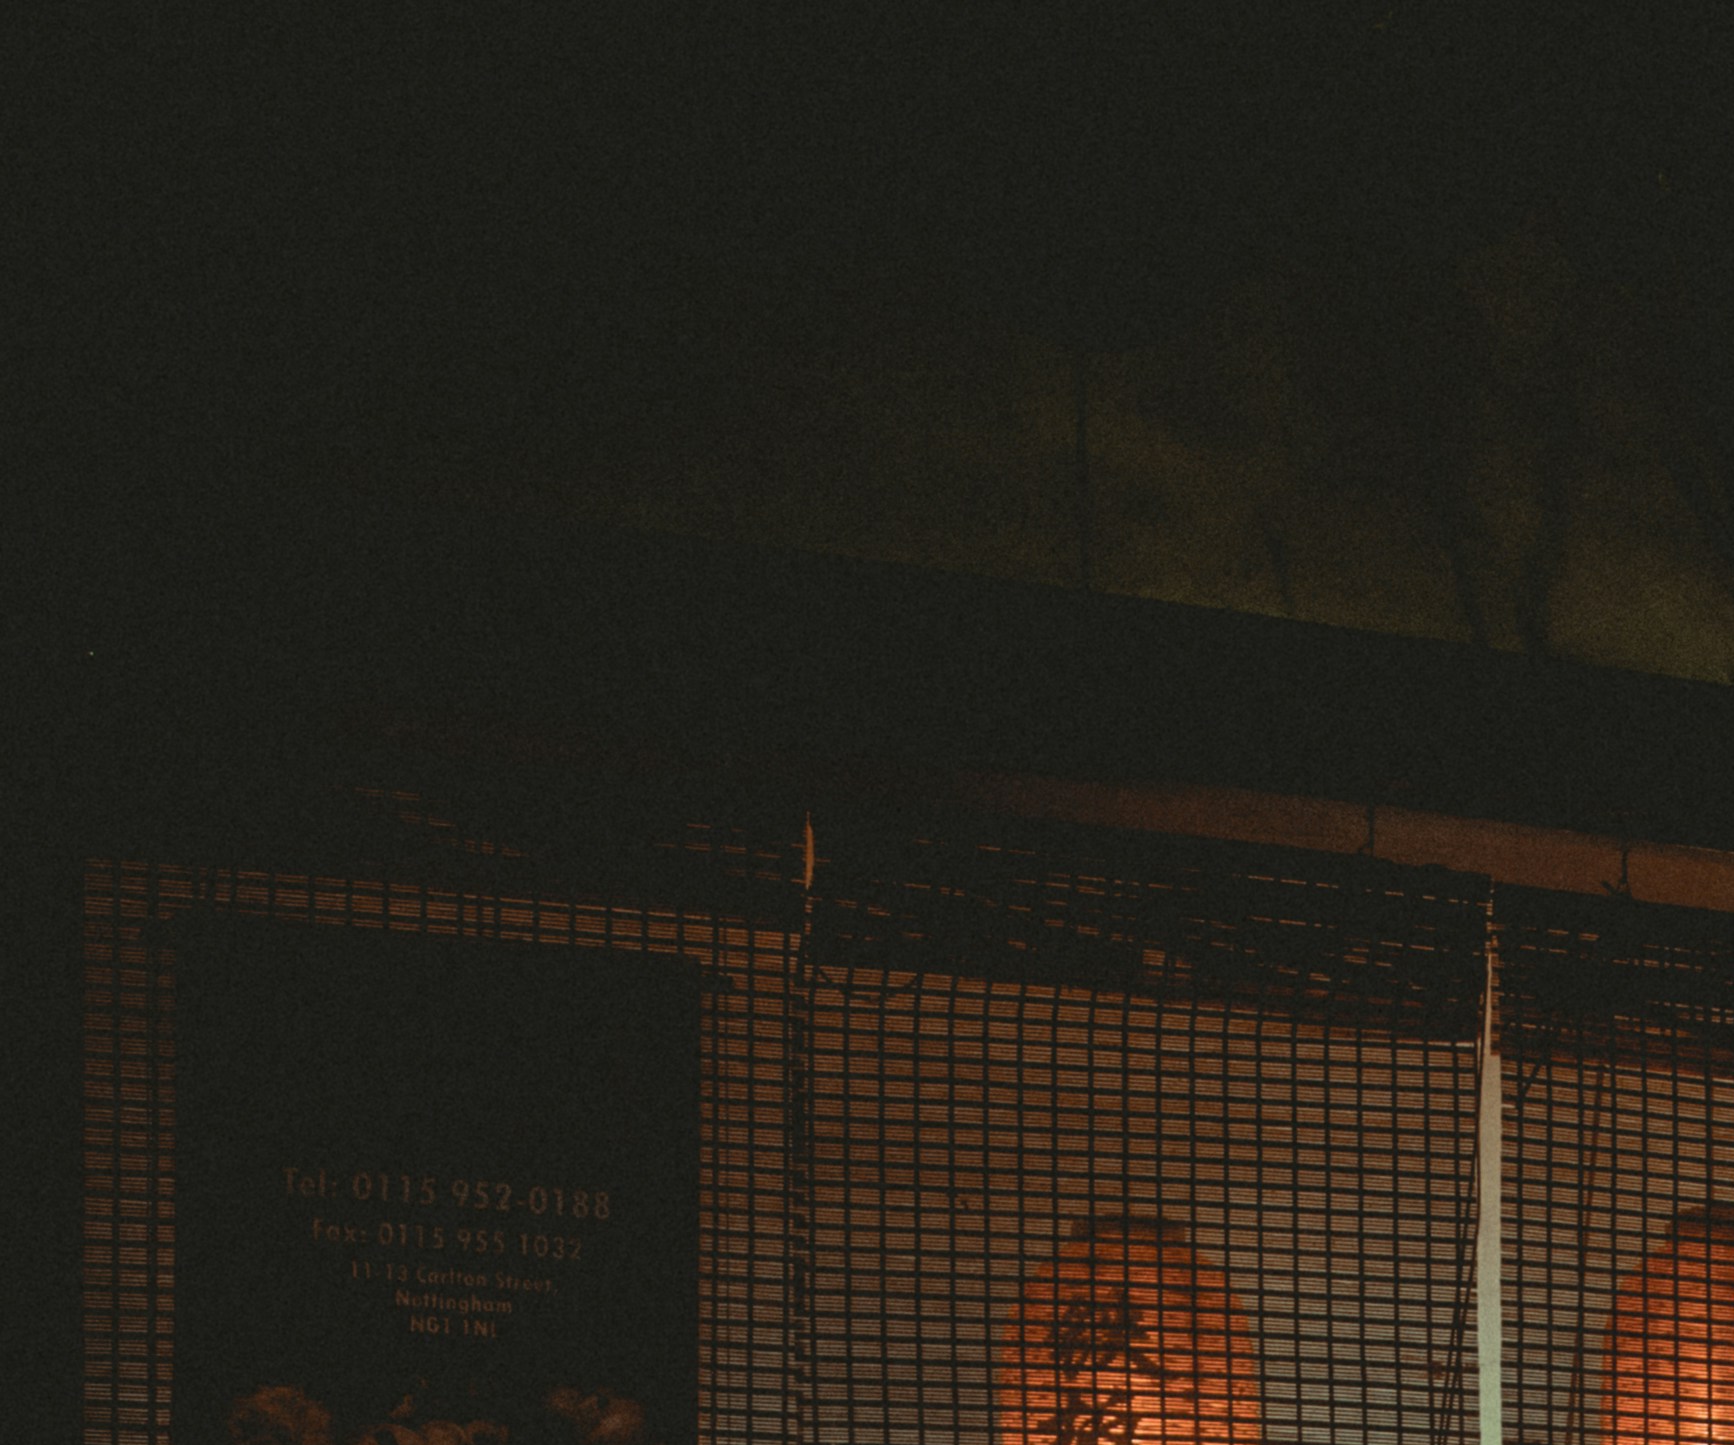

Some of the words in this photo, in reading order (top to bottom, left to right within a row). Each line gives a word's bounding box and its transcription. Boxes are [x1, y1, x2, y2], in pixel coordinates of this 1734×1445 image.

[283, 1166, 338, 1199] Tel:
[352, 1171, 437, 1205] 0115
[451, 1178, 611, 1220] 952-0188
[311, 1217, 367, 1245] Fax:
[378, 1221, 445, 1251] 0115
[457, 1228, 506, 1256] 955
[519, 1233, 583, 1261] 1032
[394, 1290, 513, 1317] Nottingham
